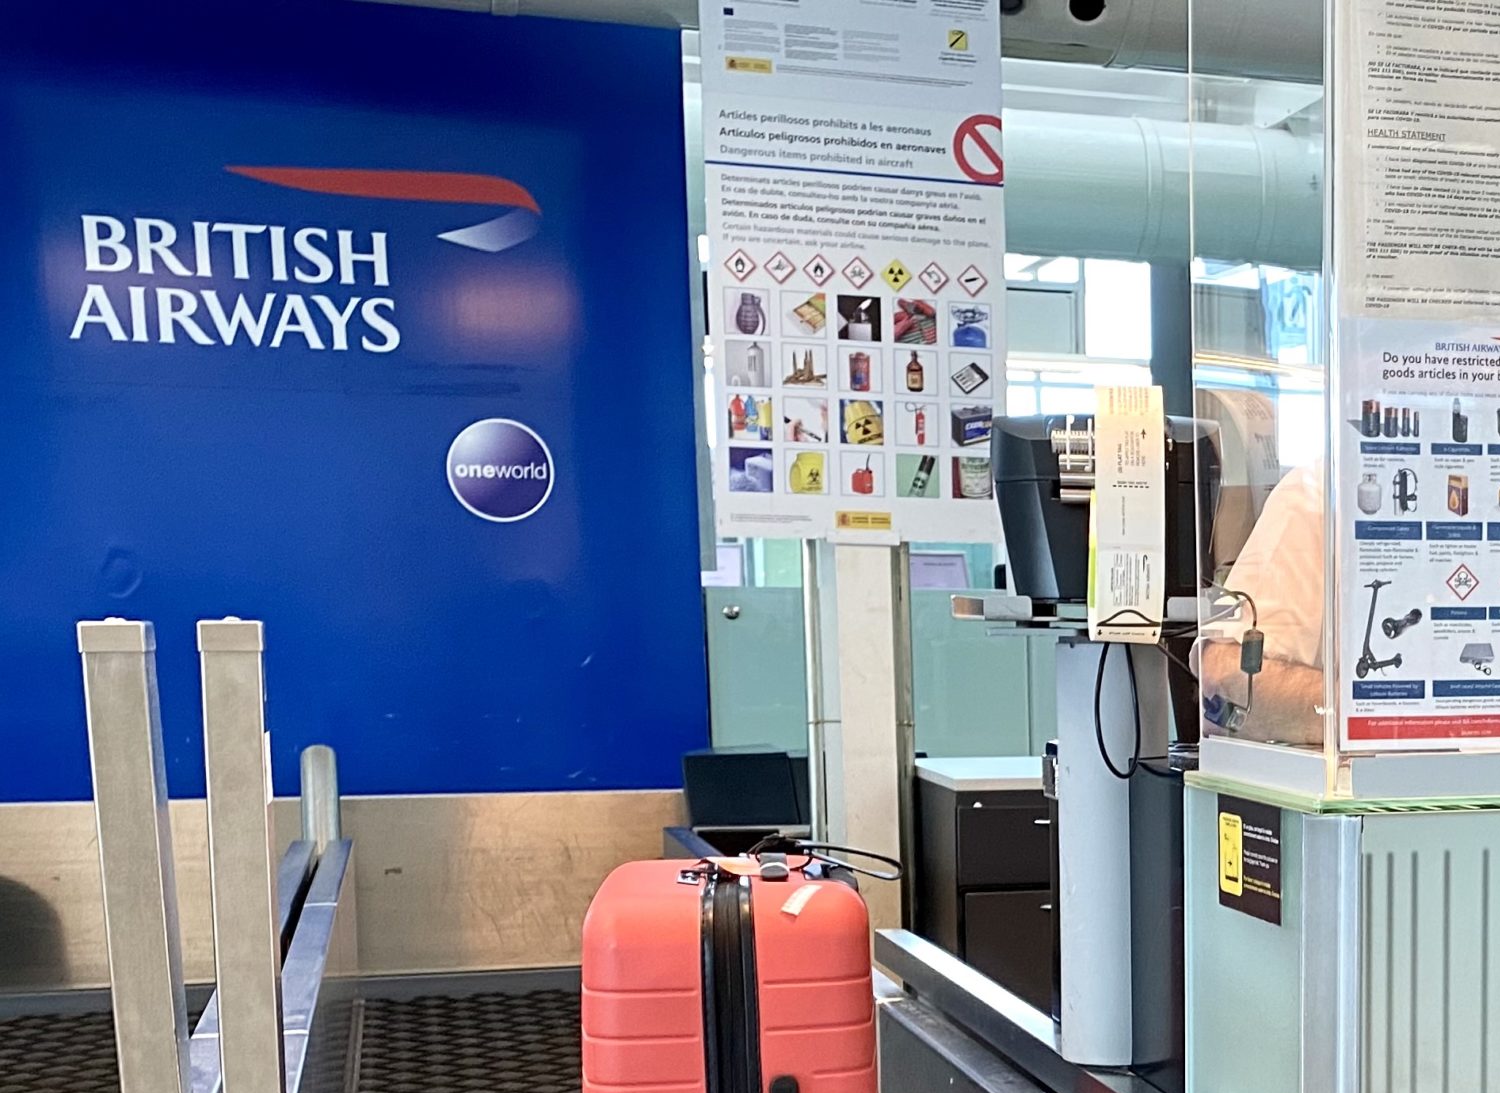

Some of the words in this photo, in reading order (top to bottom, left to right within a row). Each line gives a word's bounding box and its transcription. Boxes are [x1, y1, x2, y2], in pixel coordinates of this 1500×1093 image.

[1368, 128, 1401, 139] HEALTH
[1400, 130, 1446, 142] STATEMENT
[81, 215, 389, 286] BRITISH
[70, 284, 400, 352] AIRWAYS
[1435, 342, 1470, 352] BRITISH
[1383, 352, 1399, 363] Do
[1402, 356, 1421, 365] you
[1425, 353, 1449, 365] have
[1452, 355, 1500, 367] restricted
[1383, 367, 1415, 380] goods
[1418, 368, 1456, 380] articles
[1459, 372, 1468, 380] in
[1472, 373, 1494, 382] your
[454, 462, 547, 479] oneworld
